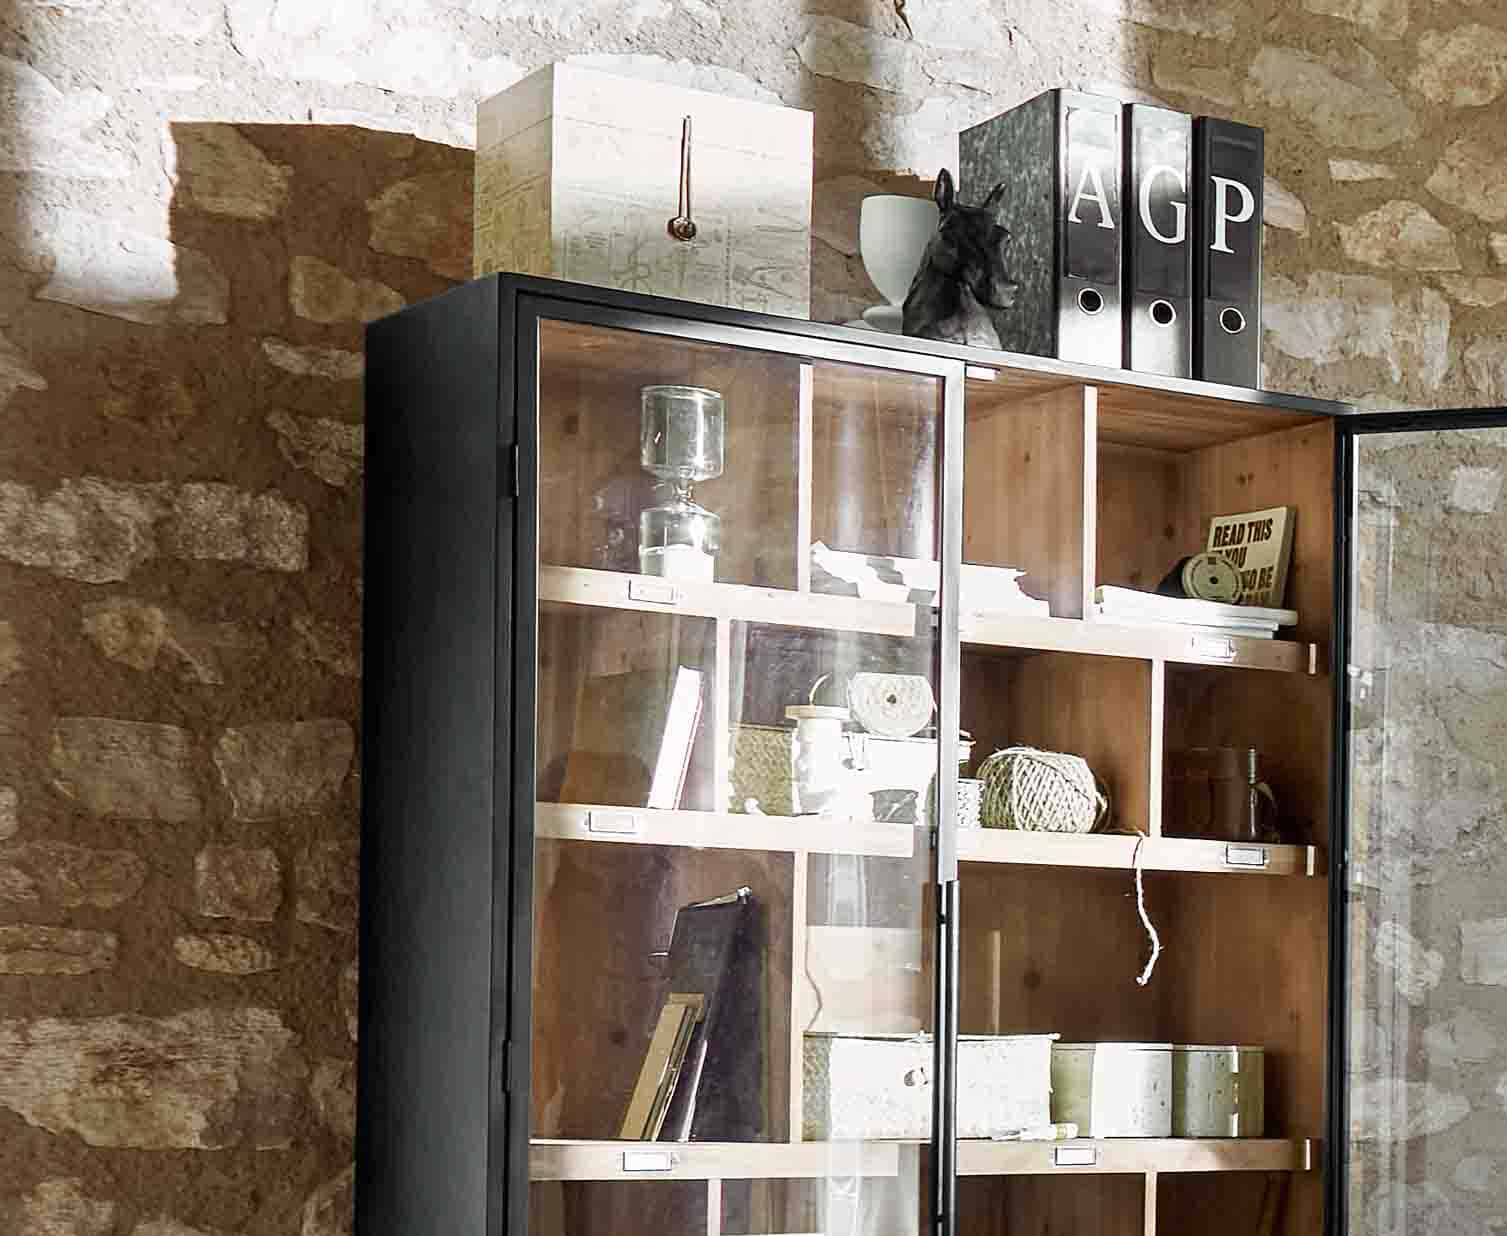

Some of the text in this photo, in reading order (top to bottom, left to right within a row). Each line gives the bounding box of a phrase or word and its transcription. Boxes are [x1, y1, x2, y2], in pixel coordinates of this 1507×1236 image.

[1068, 167, 1115, 229] A
[1139, 165, 1187, 244] G
[1209, 175, 1256, 254] P
[1214, 518, 1274, 548] READ THIS
